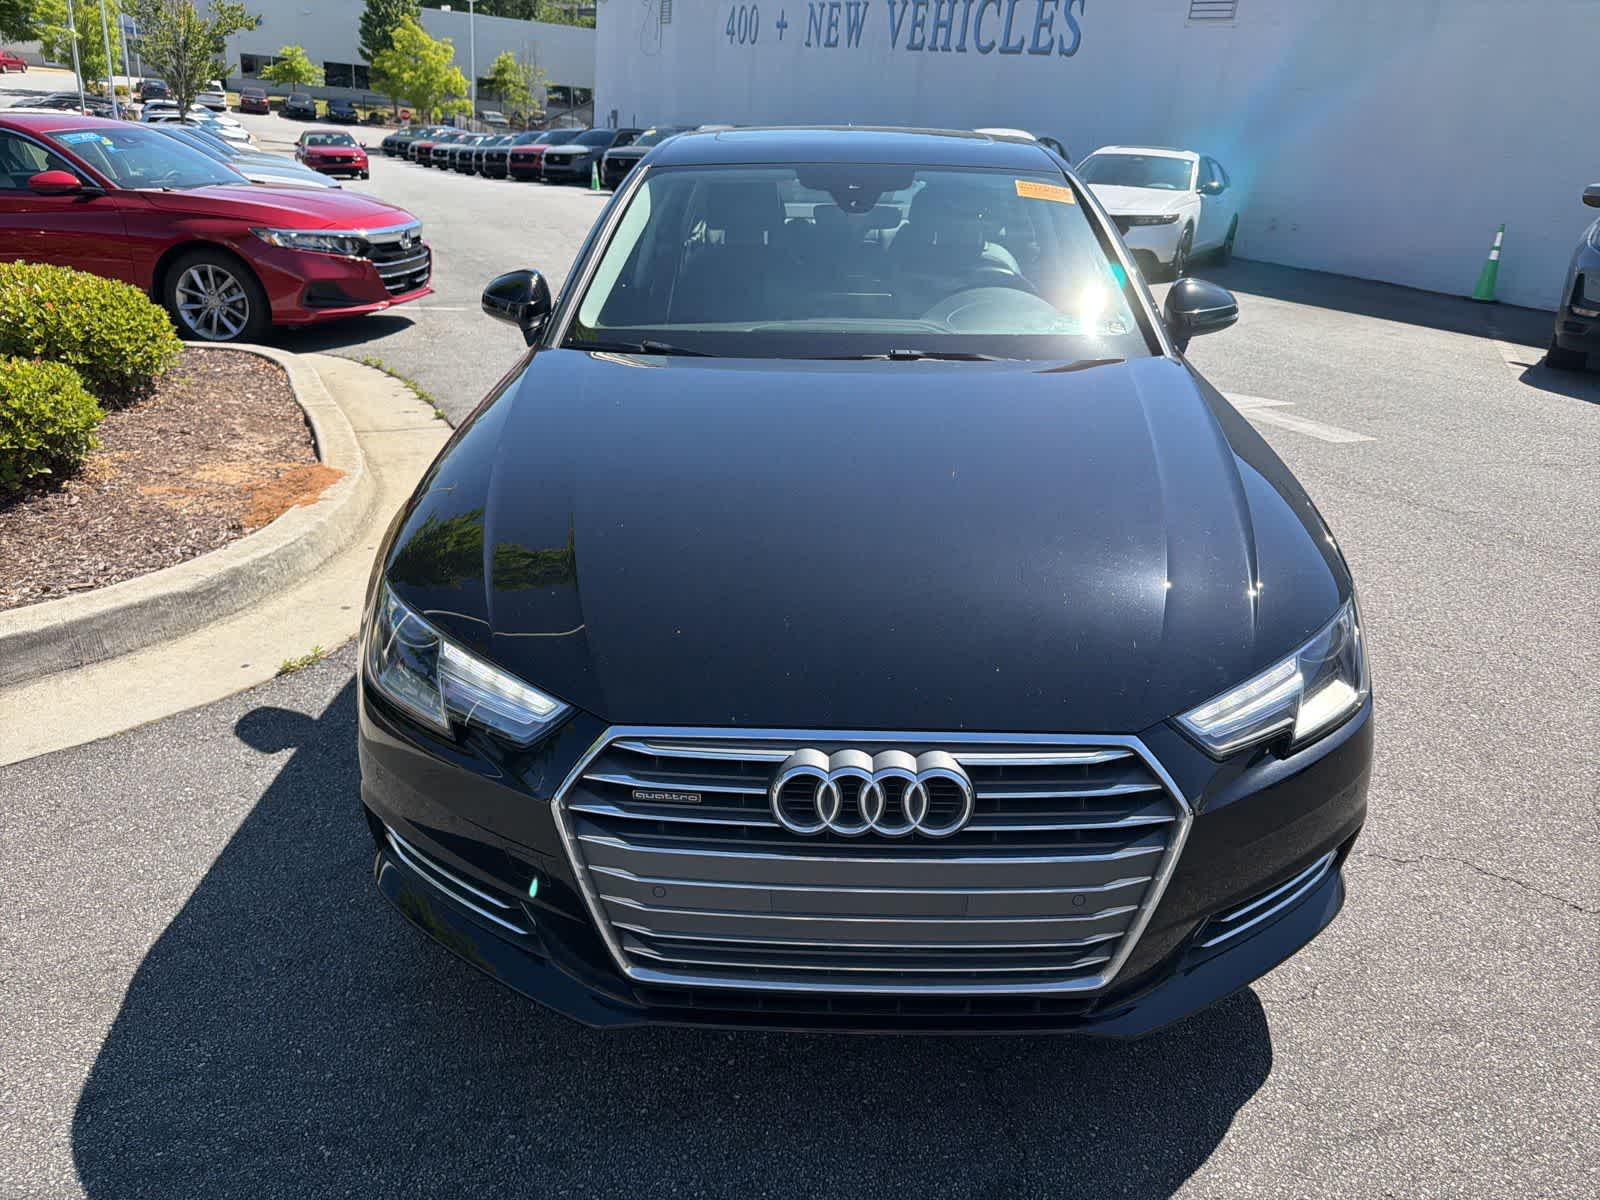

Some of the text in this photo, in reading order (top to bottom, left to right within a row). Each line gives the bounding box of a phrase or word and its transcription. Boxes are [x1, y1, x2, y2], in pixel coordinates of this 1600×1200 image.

[725, 0, 1085, 57] 400 + NEW VEHICLES
[635, 792, 698, 801] quattro
